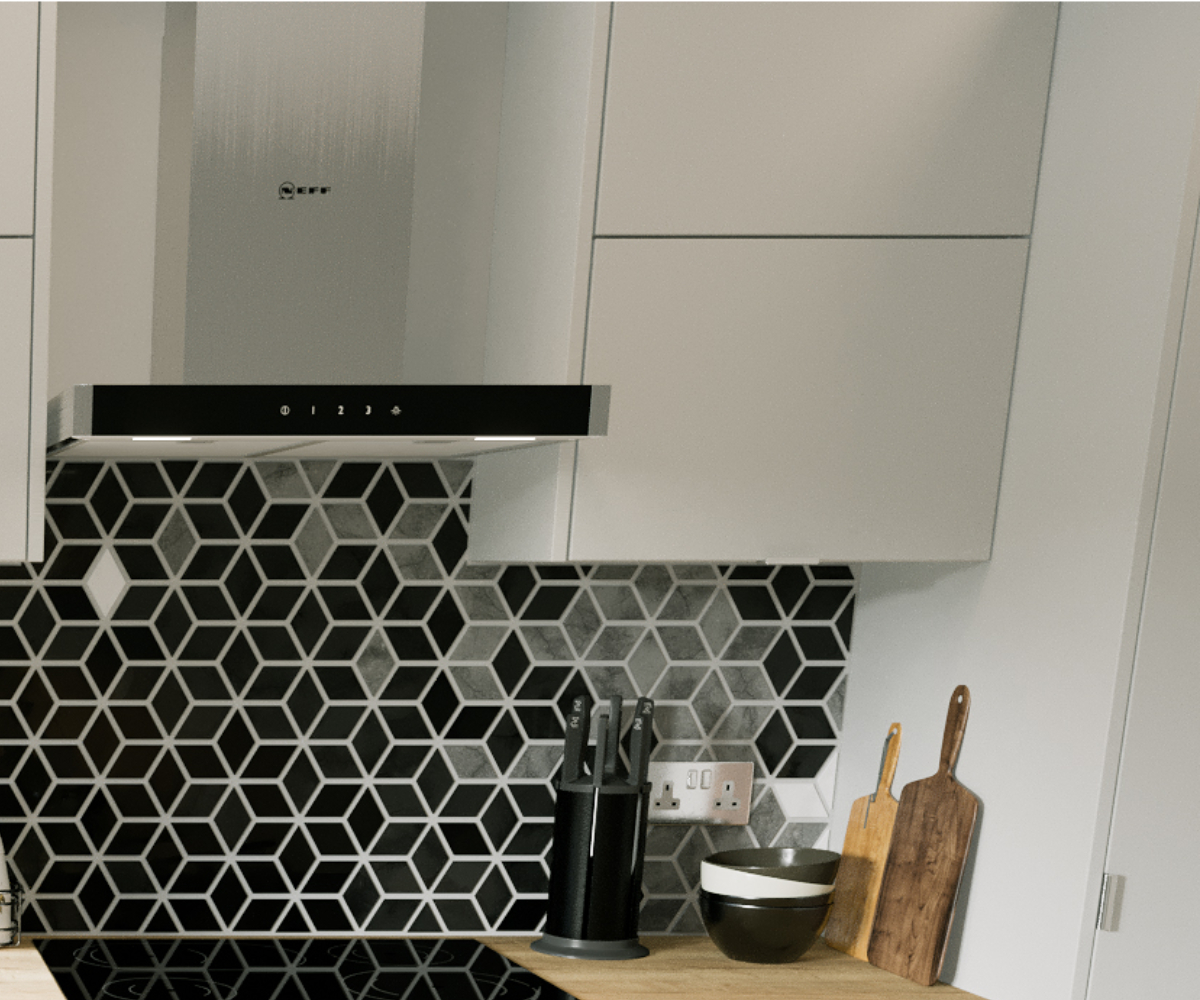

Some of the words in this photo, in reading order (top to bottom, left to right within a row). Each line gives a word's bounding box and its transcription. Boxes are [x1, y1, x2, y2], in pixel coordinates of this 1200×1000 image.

[280, 184, 331, 197] NEFF
[337, 405, 345, 415] 2
[364, 405, 372, 415] 3
